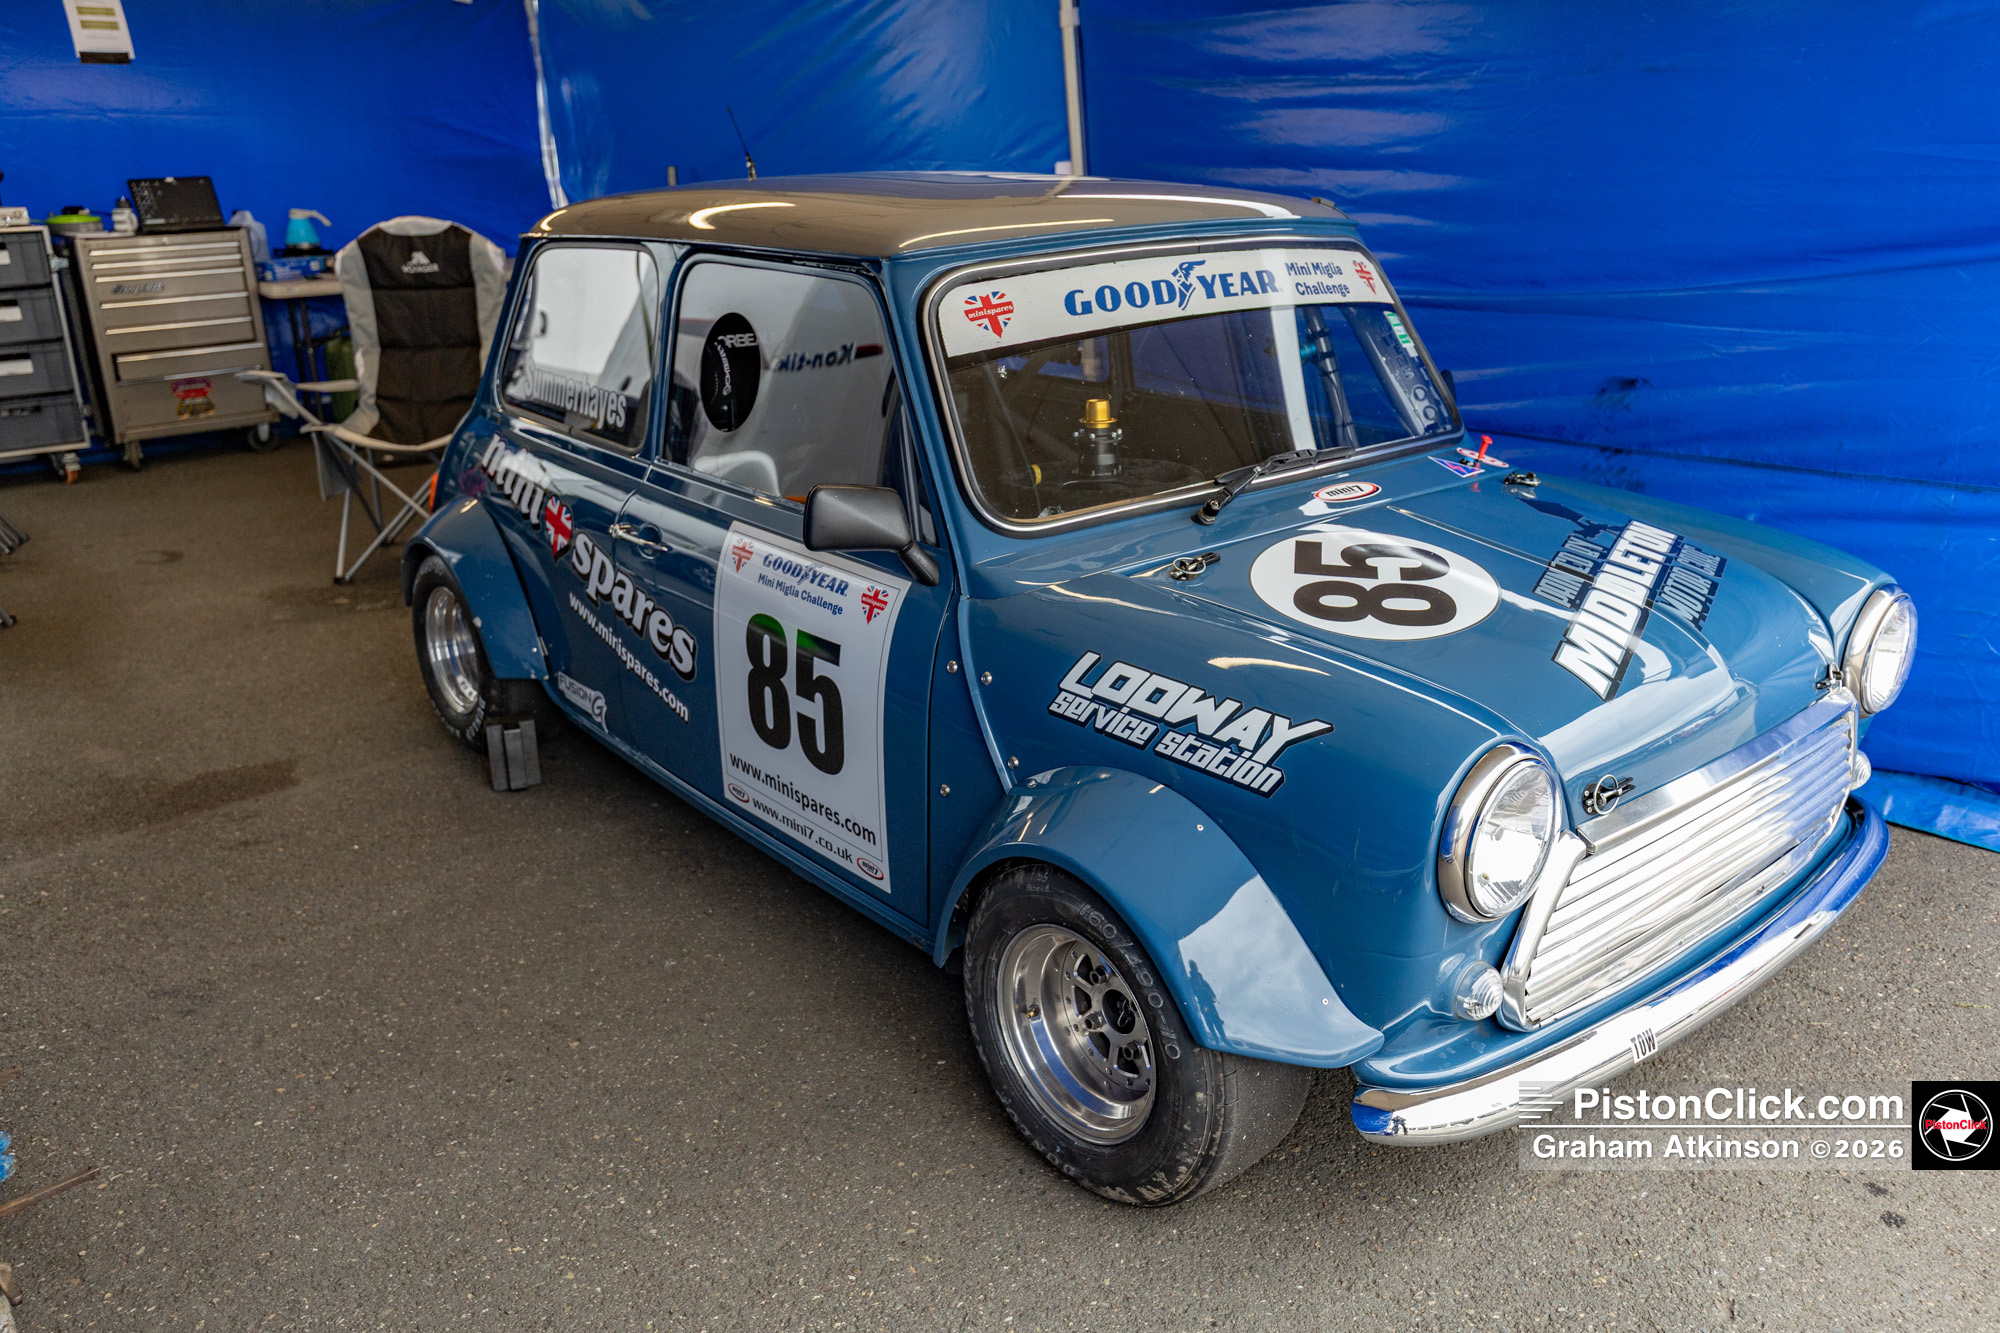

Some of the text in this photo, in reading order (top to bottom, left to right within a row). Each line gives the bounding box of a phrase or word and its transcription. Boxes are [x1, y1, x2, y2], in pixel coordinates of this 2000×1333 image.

[1064, 269, 1279, 317] GOODYEAR
[1285, 262, 1312, 277] Mini
[1312, 262, 1343, 279] Miglia
[1296, 282, 1350, 298] Challenge
[967, 304, 1015, 319] minispares
[525, 357, 627, 430] Summerhayes
[1326, 484, 1365, 497] mini7
[571, 532, 696, 675] spares
[757, 573, 844, 616] Mini Miglia Challenge
[762, 553, 850, 597] GOODYEAR
[1293, 540, 1457, 626] 85
[1554, 519, 1679, 700] MIDDLETON
[1657, 542, 1722, 622] MOTOR CARE
[569, 592, 690, 723] www.minispares.com
[746, 612, 845, 776] 85
[1049, 690, 1283, 793] service station
[729, 753, 877, 847] www.minispares.com
[752, 797, 854, 864] www.mini7.co.uk
[1630, 1027, 1656, 1060] TOW
